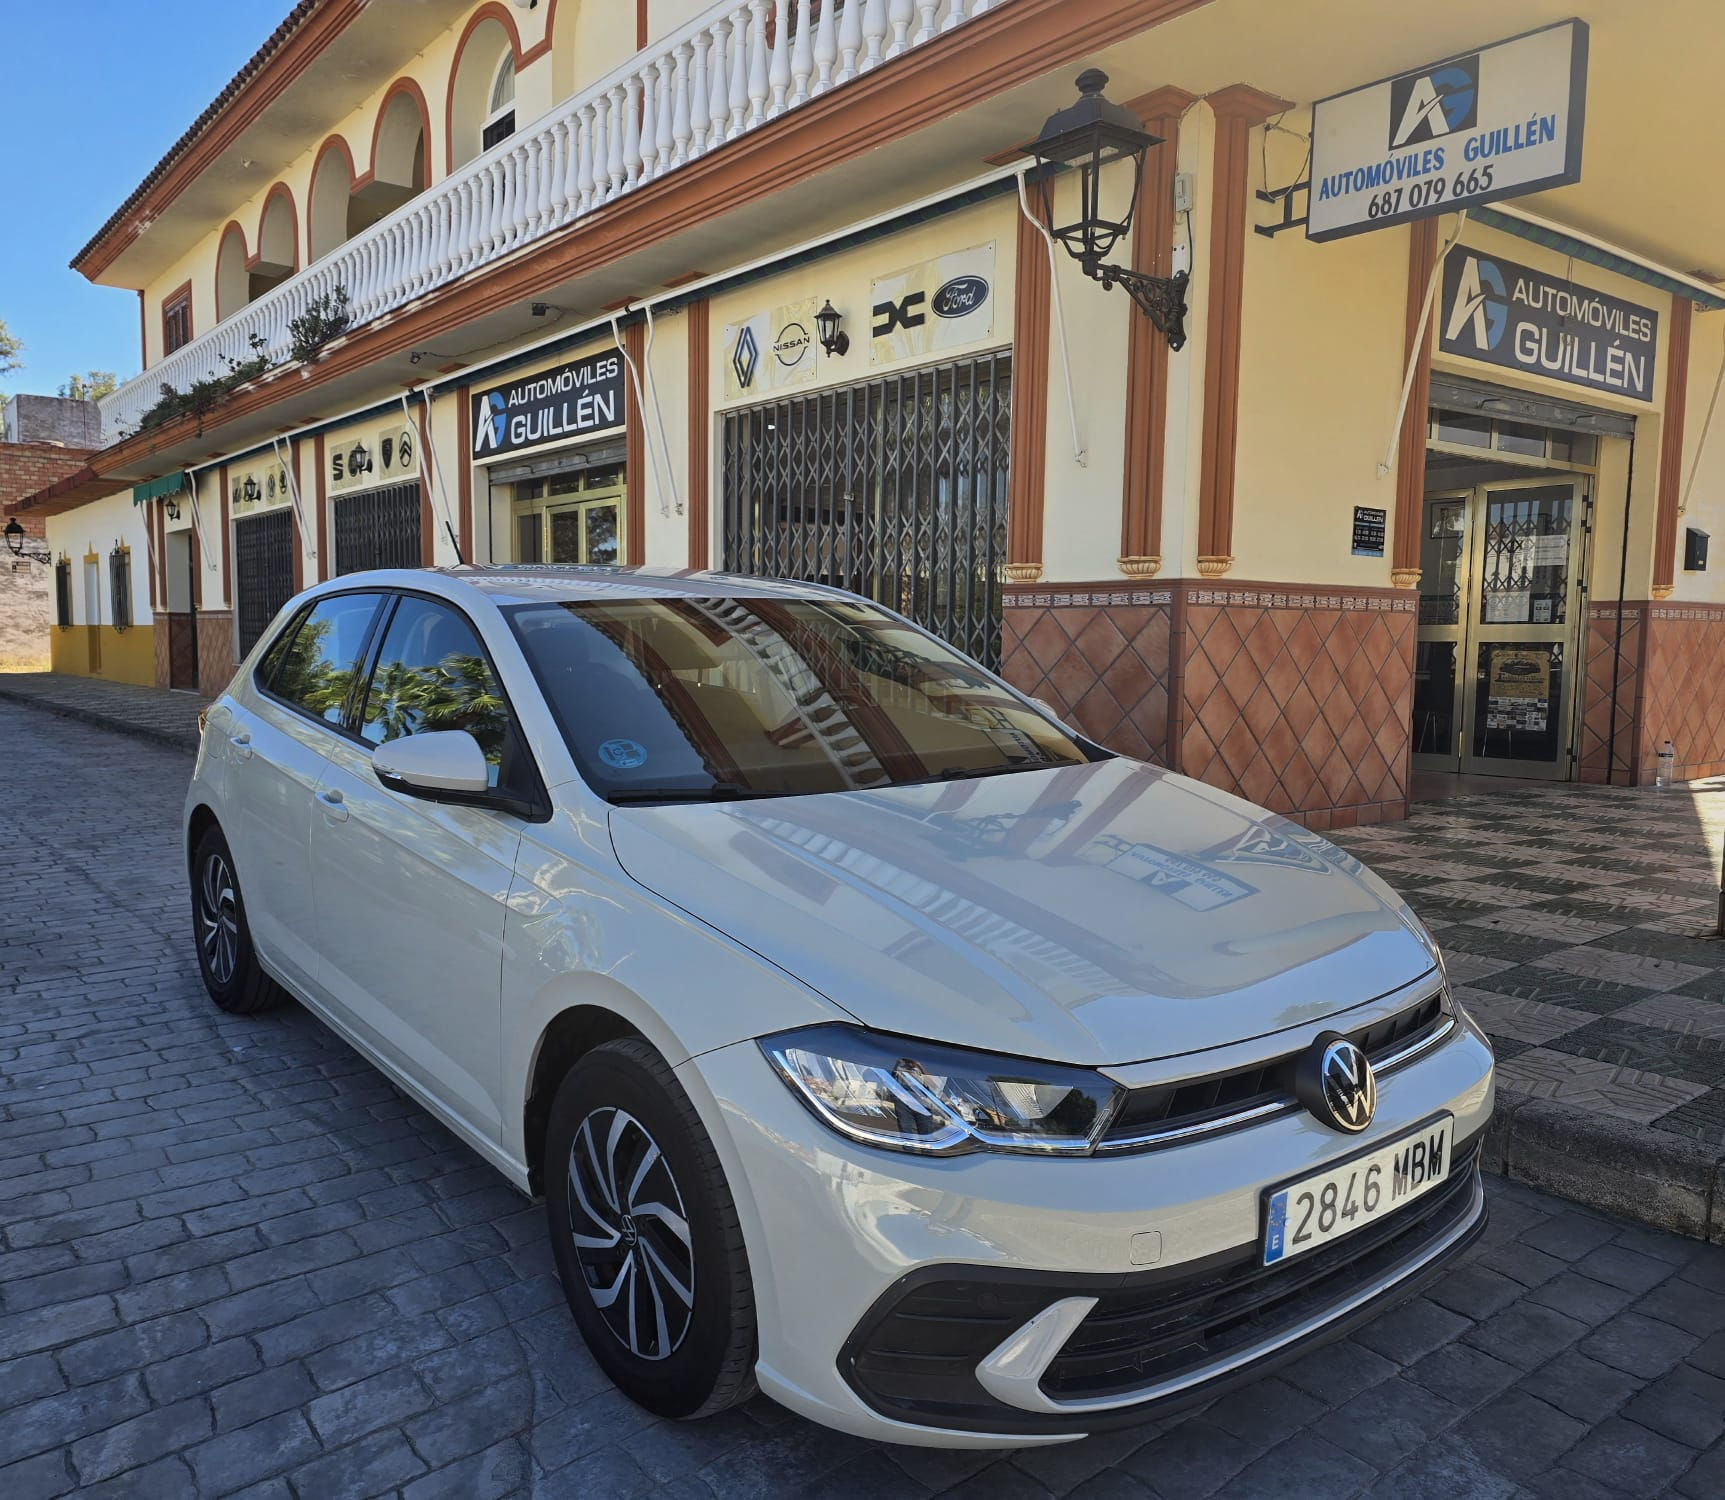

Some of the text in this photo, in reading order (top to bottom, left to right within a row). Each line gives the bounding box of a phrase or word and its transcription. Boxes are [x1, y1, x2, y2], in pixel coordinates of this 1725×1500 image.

[1319, 112, 1556, 201] AUTOMÓVILES GUILLÉN
[1368, 164, 1494, 218] 687 079 665
[943, 284, 977, 311] Ford
[1512, 278, 1651, 342] AUTOMÓVILES
[773, 336, 810, 352] NISSAN
[1514, 321, 1645, 392] GUILLÉN
[508, 357, 618, 408] AUTOMÓVILES
[510, 389, 615, 444] GUILLÉN
[1292, 1129, 1443, 1245] 2846 MBM
[1272, 1234, 1279, 1250] E
